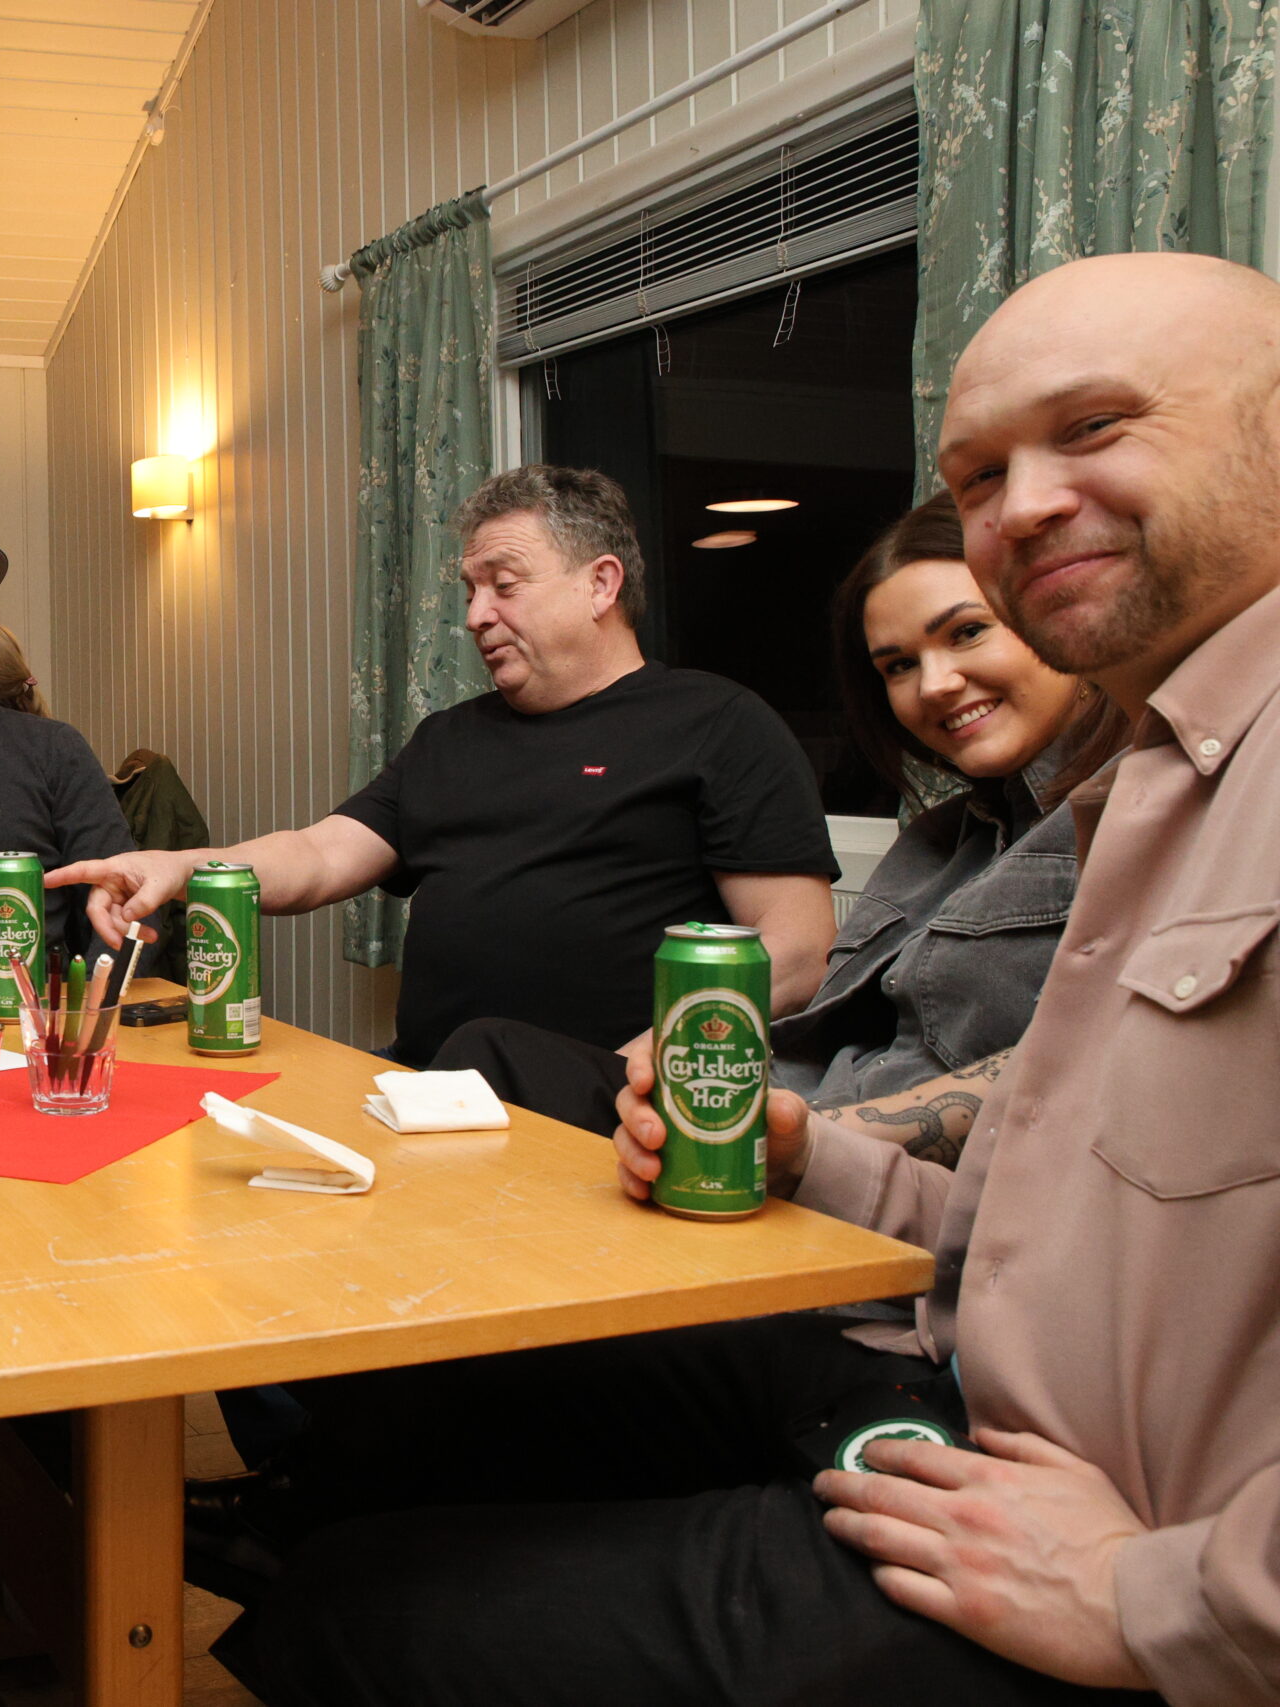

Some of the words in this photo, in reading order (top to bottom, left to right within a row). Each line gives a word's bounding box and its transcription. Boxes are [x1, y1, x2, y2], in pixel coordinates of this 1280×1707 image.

[695, 946, 737, 955] ORGANIC
[189, 967, 212, 981] Hof
[693, 1042, 737, 1051] ORGANIC
[663, 1045, 763, 1084] Carlsberg
[692, 1087, 740, 1109] Hof
